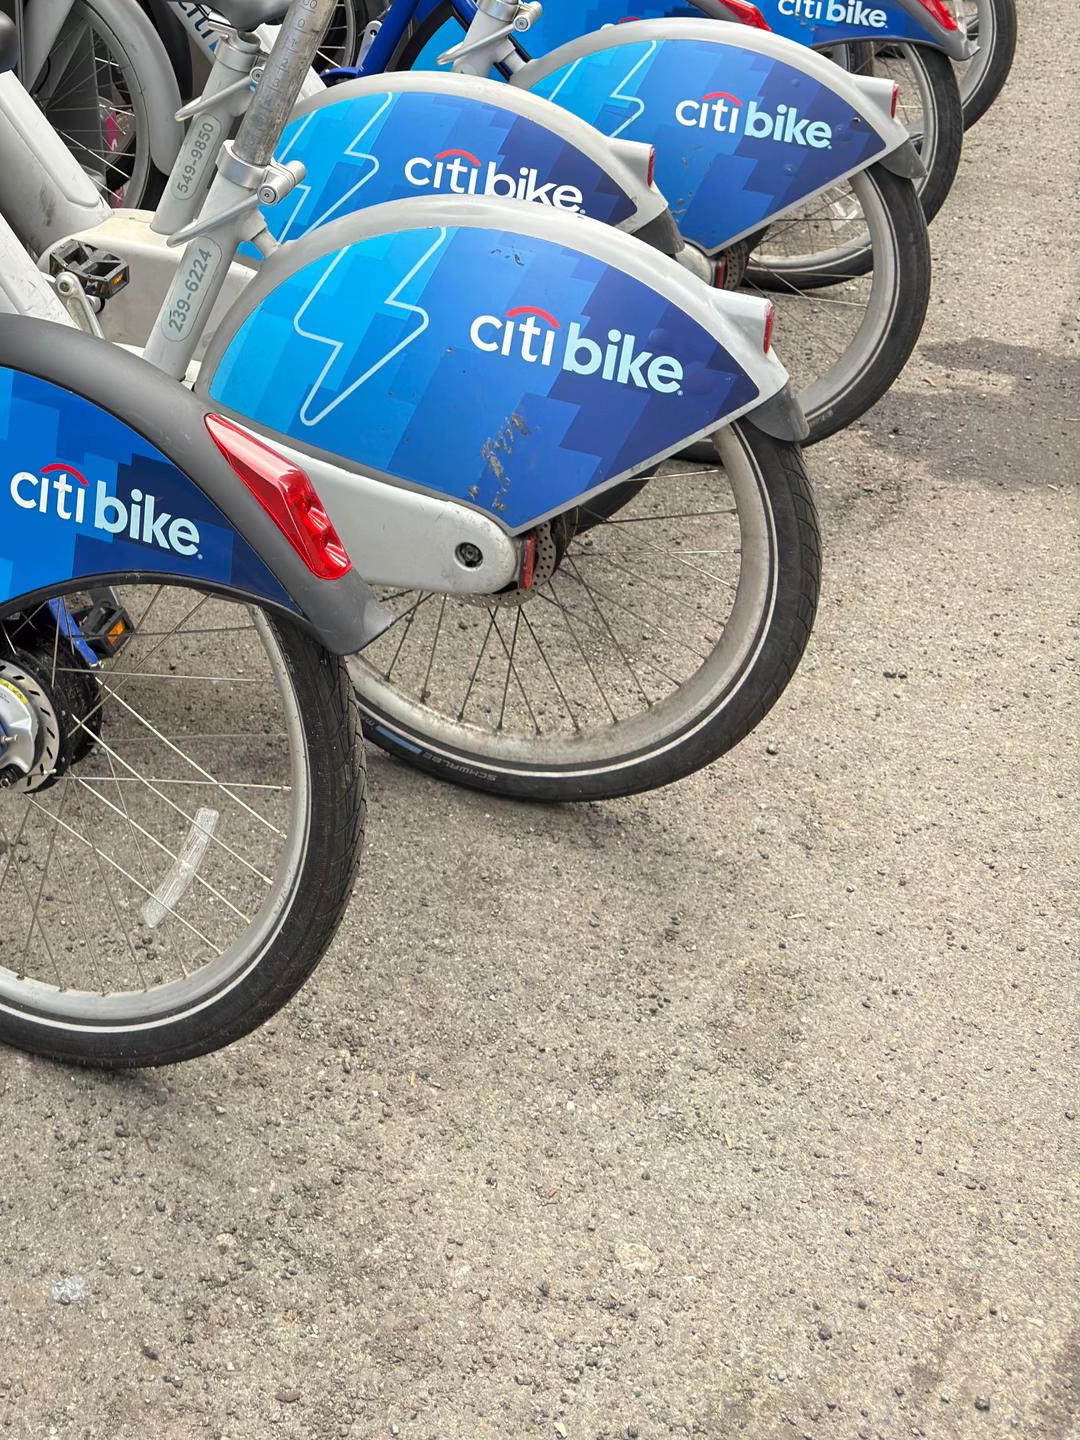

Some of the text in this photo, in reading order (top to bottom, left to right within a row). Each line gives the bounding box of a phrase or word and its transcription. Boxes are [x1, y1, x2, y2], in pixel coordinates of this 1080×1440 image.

[676, 93, 832, 150] citi bike
[177, 122, 215, 194] 549-9850
[404, 150, 584, 213] citi bike
[168, 248, 212, 333] 239-6224
[470, 308, 684, 396] citi bike
[10, 465, 201, 558] citi bike
[422, 752, 499, 782] SCHWALBE
